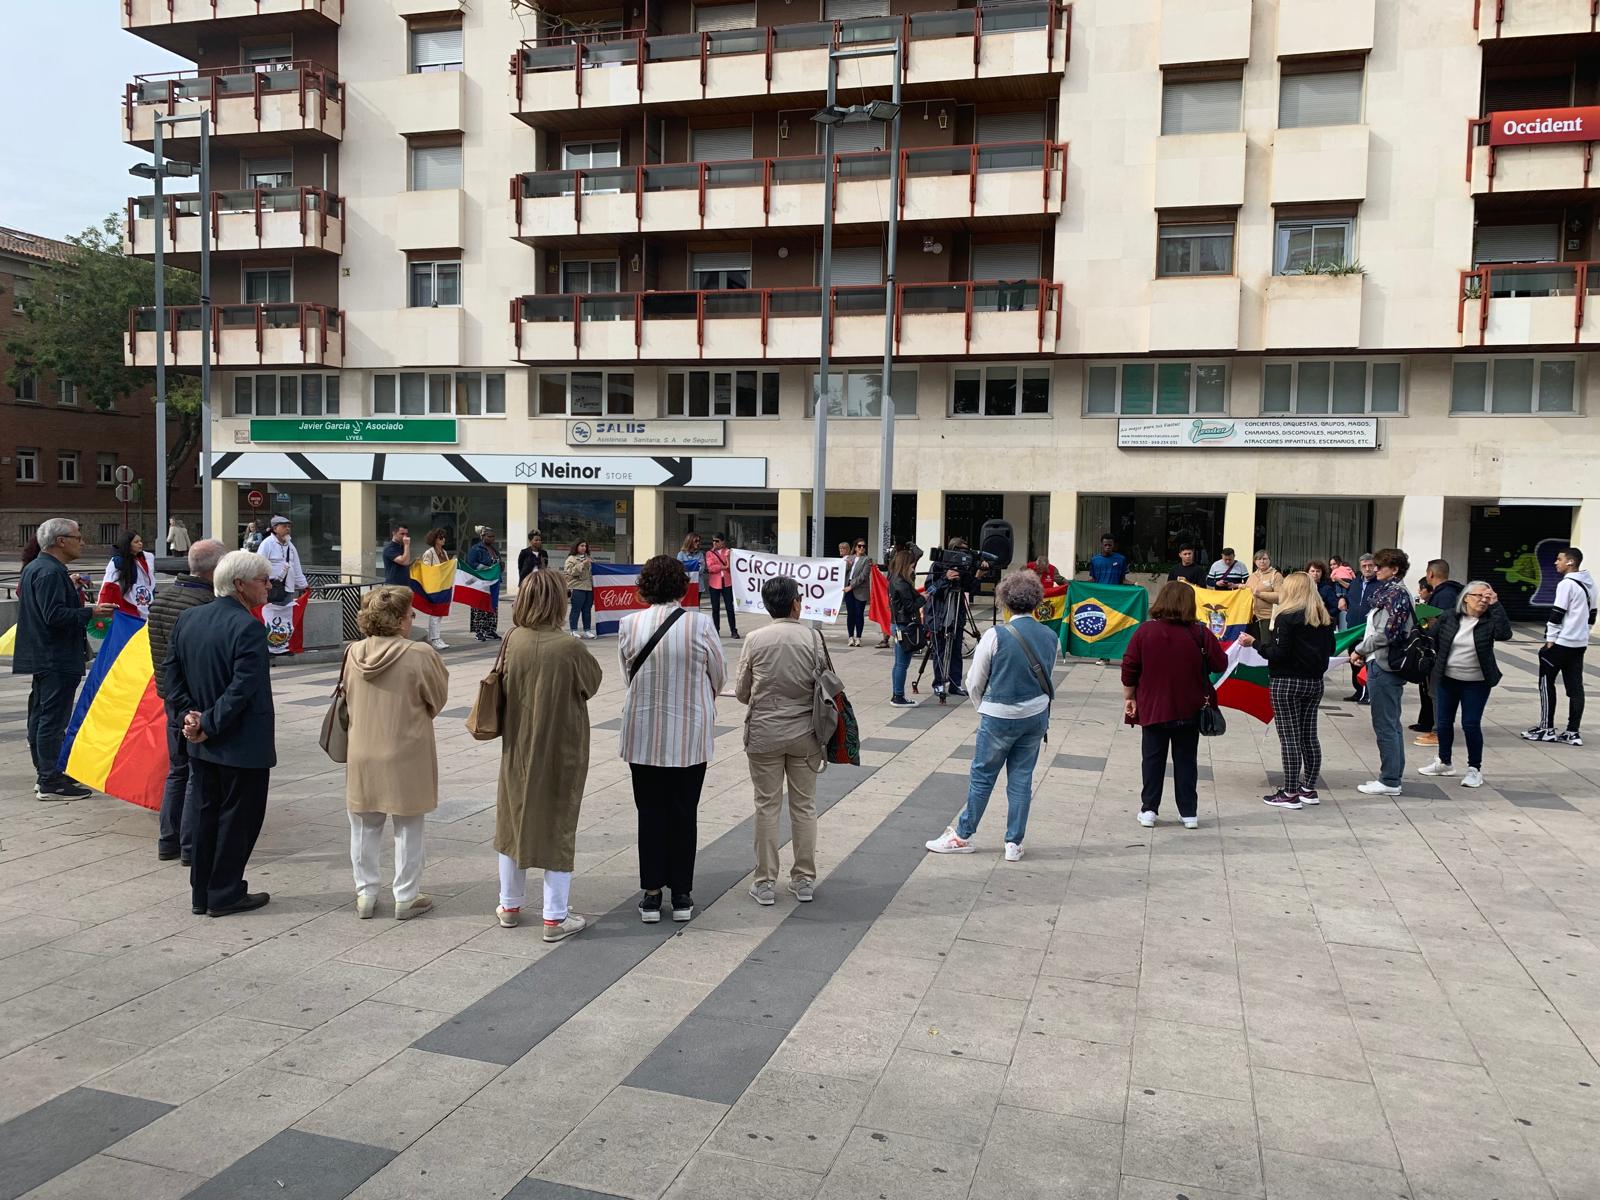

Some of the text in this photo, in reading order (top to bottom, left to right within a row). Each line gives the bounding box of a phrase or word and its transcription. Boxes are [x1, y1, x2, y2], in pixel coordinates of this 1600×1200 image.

[1503, 117, 1583, 135] Occident
[298, 421, 324, 430] Javier
[365, 421, 404, 430] Asociado
[596, 423, 646, 433] SALUS
[692, 436, 718, 444] Seguros
[541, 462, 633, 480] Neinor STORE
[735, 554, 839, 582] CÍRCULO DE
[747, 577, 825, 600] SIIO
[599, 589, 634, 608] Costa
